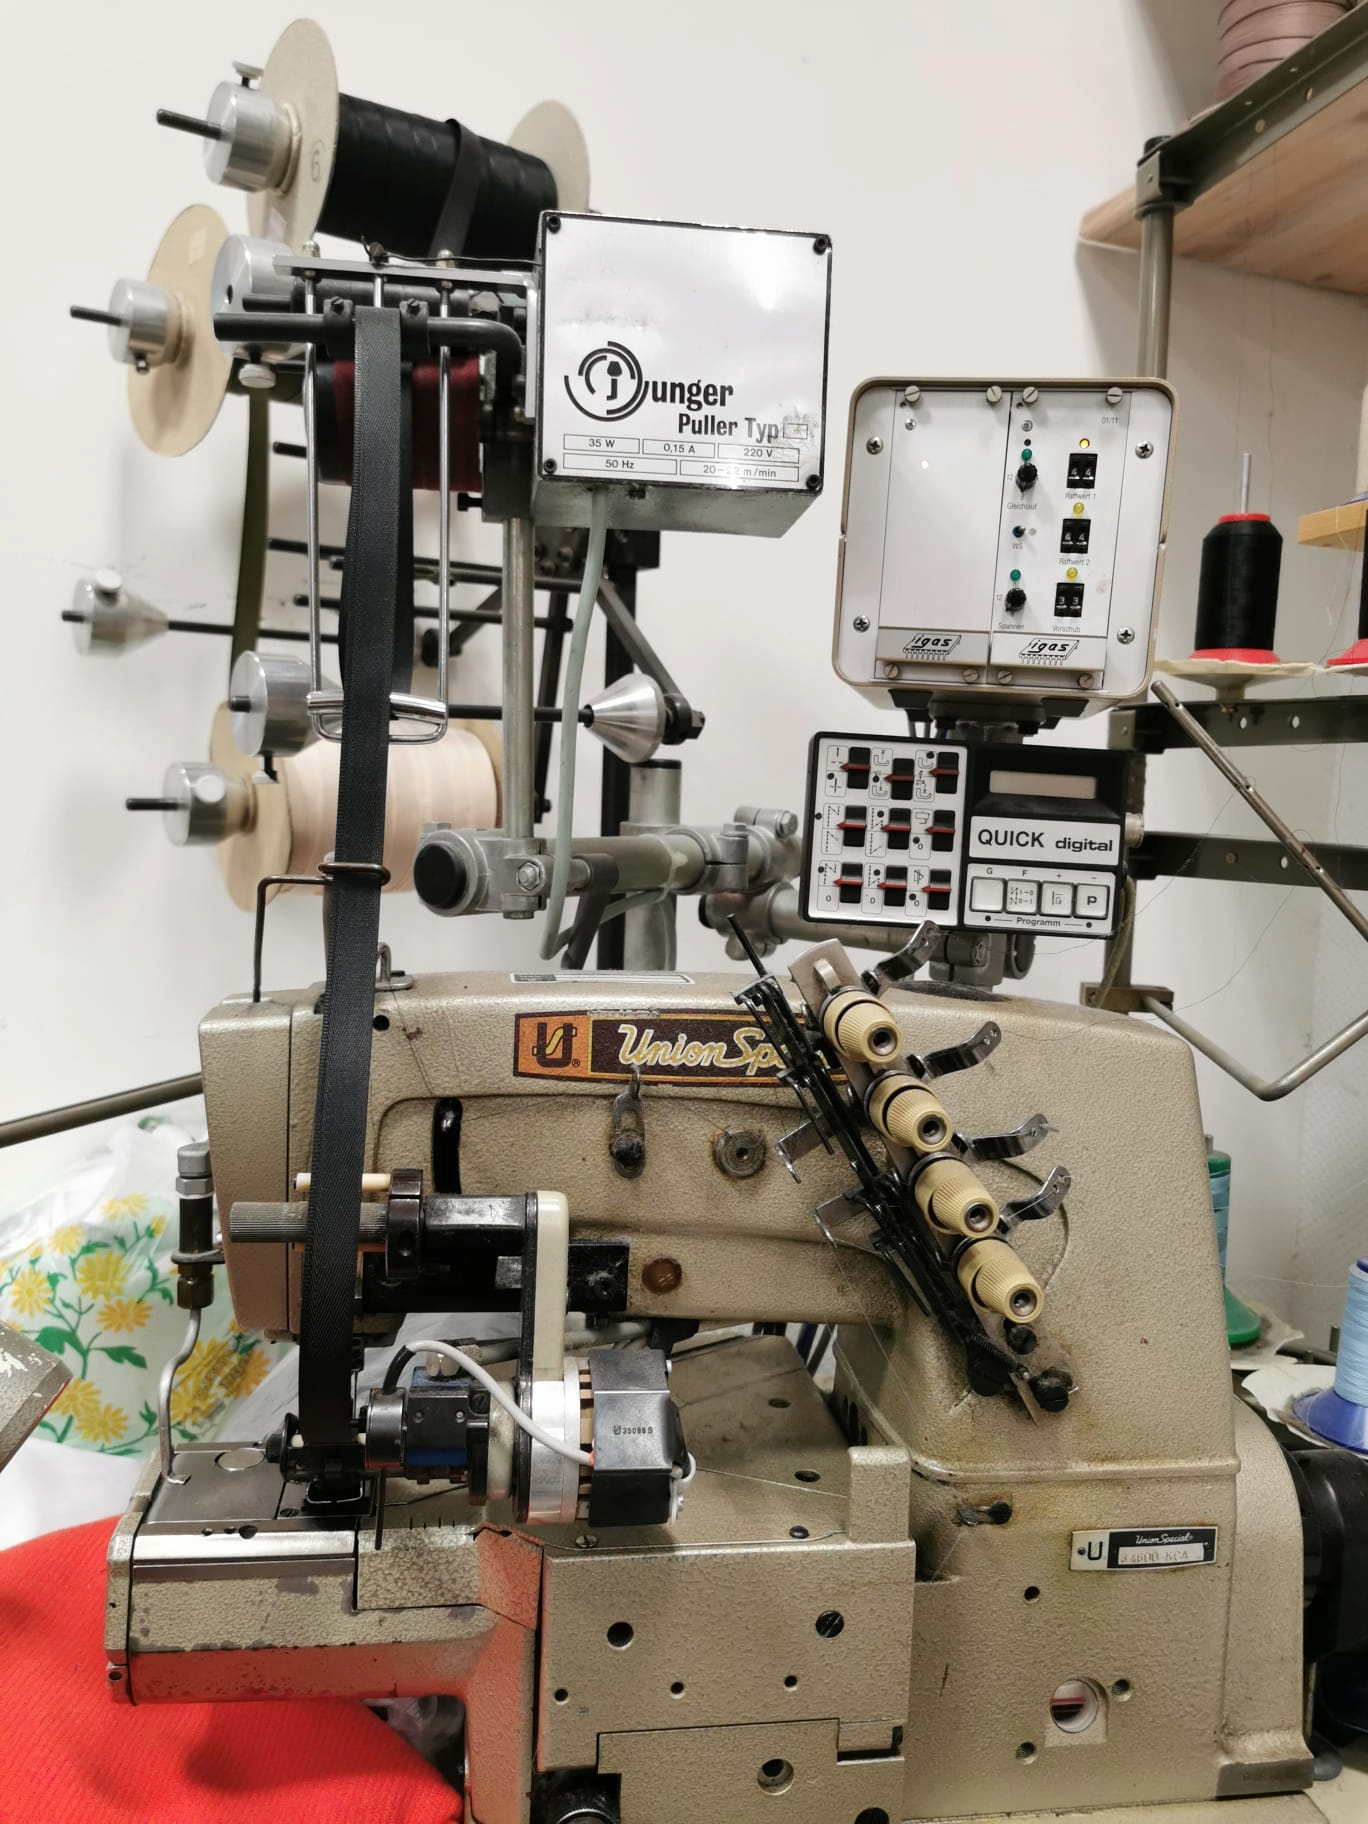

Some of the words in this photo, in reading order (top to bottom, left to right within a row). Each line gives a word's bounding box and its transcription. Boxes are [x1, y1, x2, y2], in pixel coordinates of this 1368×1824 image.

[678, 413, 738, 436] Puller
[744, 417, 779, 443] Typ
[588, 438, 602, 448] 35
[605, 439, 615, 448] W
[663, 443, 685, 453] 0,15
[688, 445, 696, 454] A
[743, 447, 763, 458] 220
[766, 449, 773, 458] V
[605, 459, 619, 468] 50
[622, 460, 635, 469] Hz
[1012, 542, 1023, 550] WS
[1052, 624, 1080, 633] Vorschub
[911, 634, 953, 649] igas
[1028, 639, 1070, 654] igas
[978, 829, 1045, 848] QUICK
[1055, 837, 1113, 852] digital
[986, 867, 993, 875] G
[1022, 869, 1028, 877] F
[1016, 917, 1061, 927] Programm
